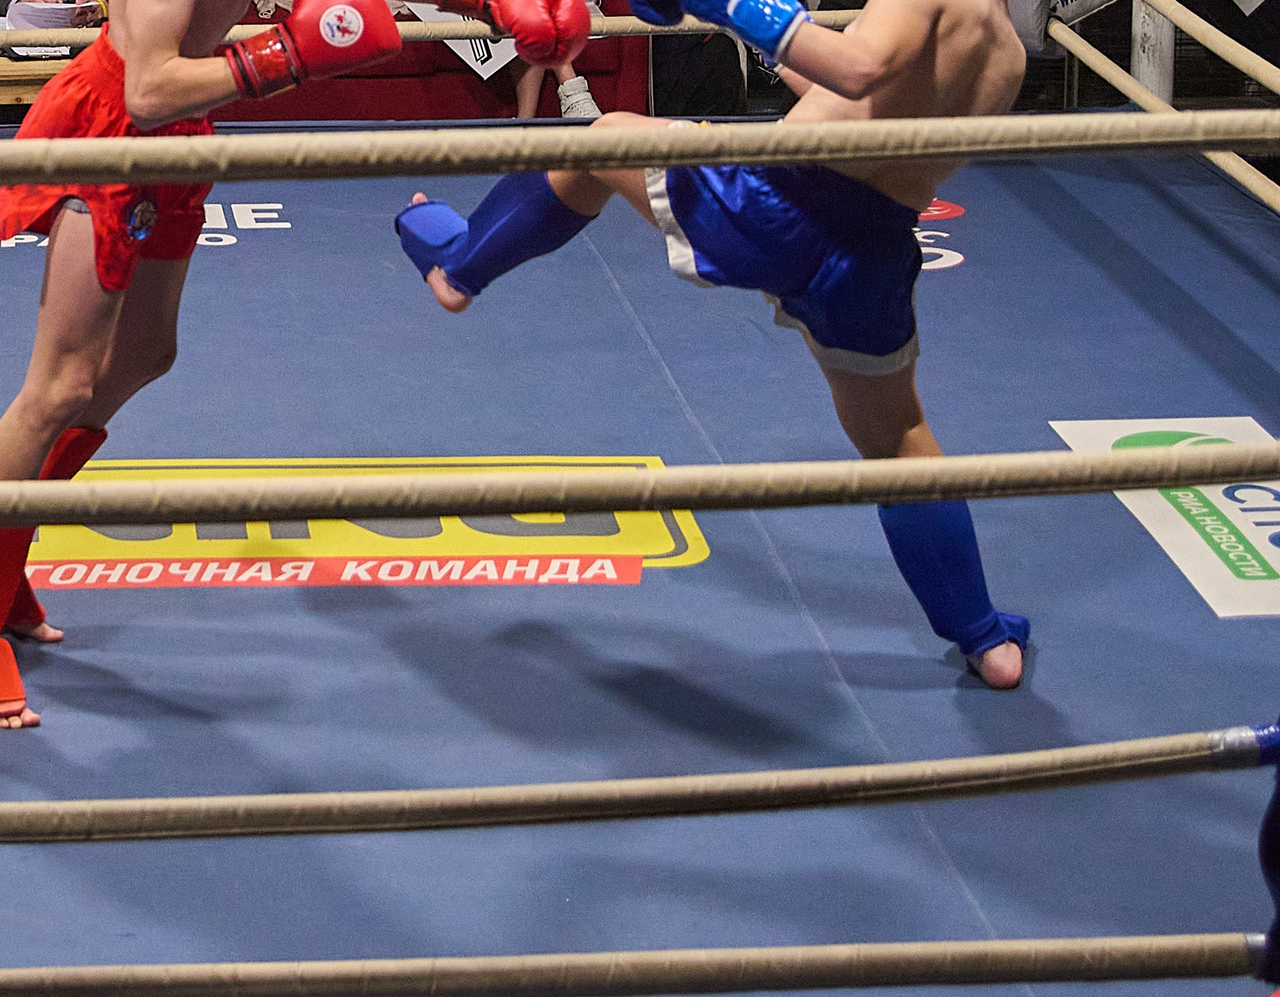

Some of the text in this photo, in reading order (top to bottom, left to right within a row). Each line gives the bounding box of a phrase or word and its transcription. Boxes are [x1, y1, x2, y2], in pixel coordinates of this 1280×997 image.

[1170, 490, 1268, 578] РИА НОВОСТИ
[340, 557, 619, 584] КОМАНДА
